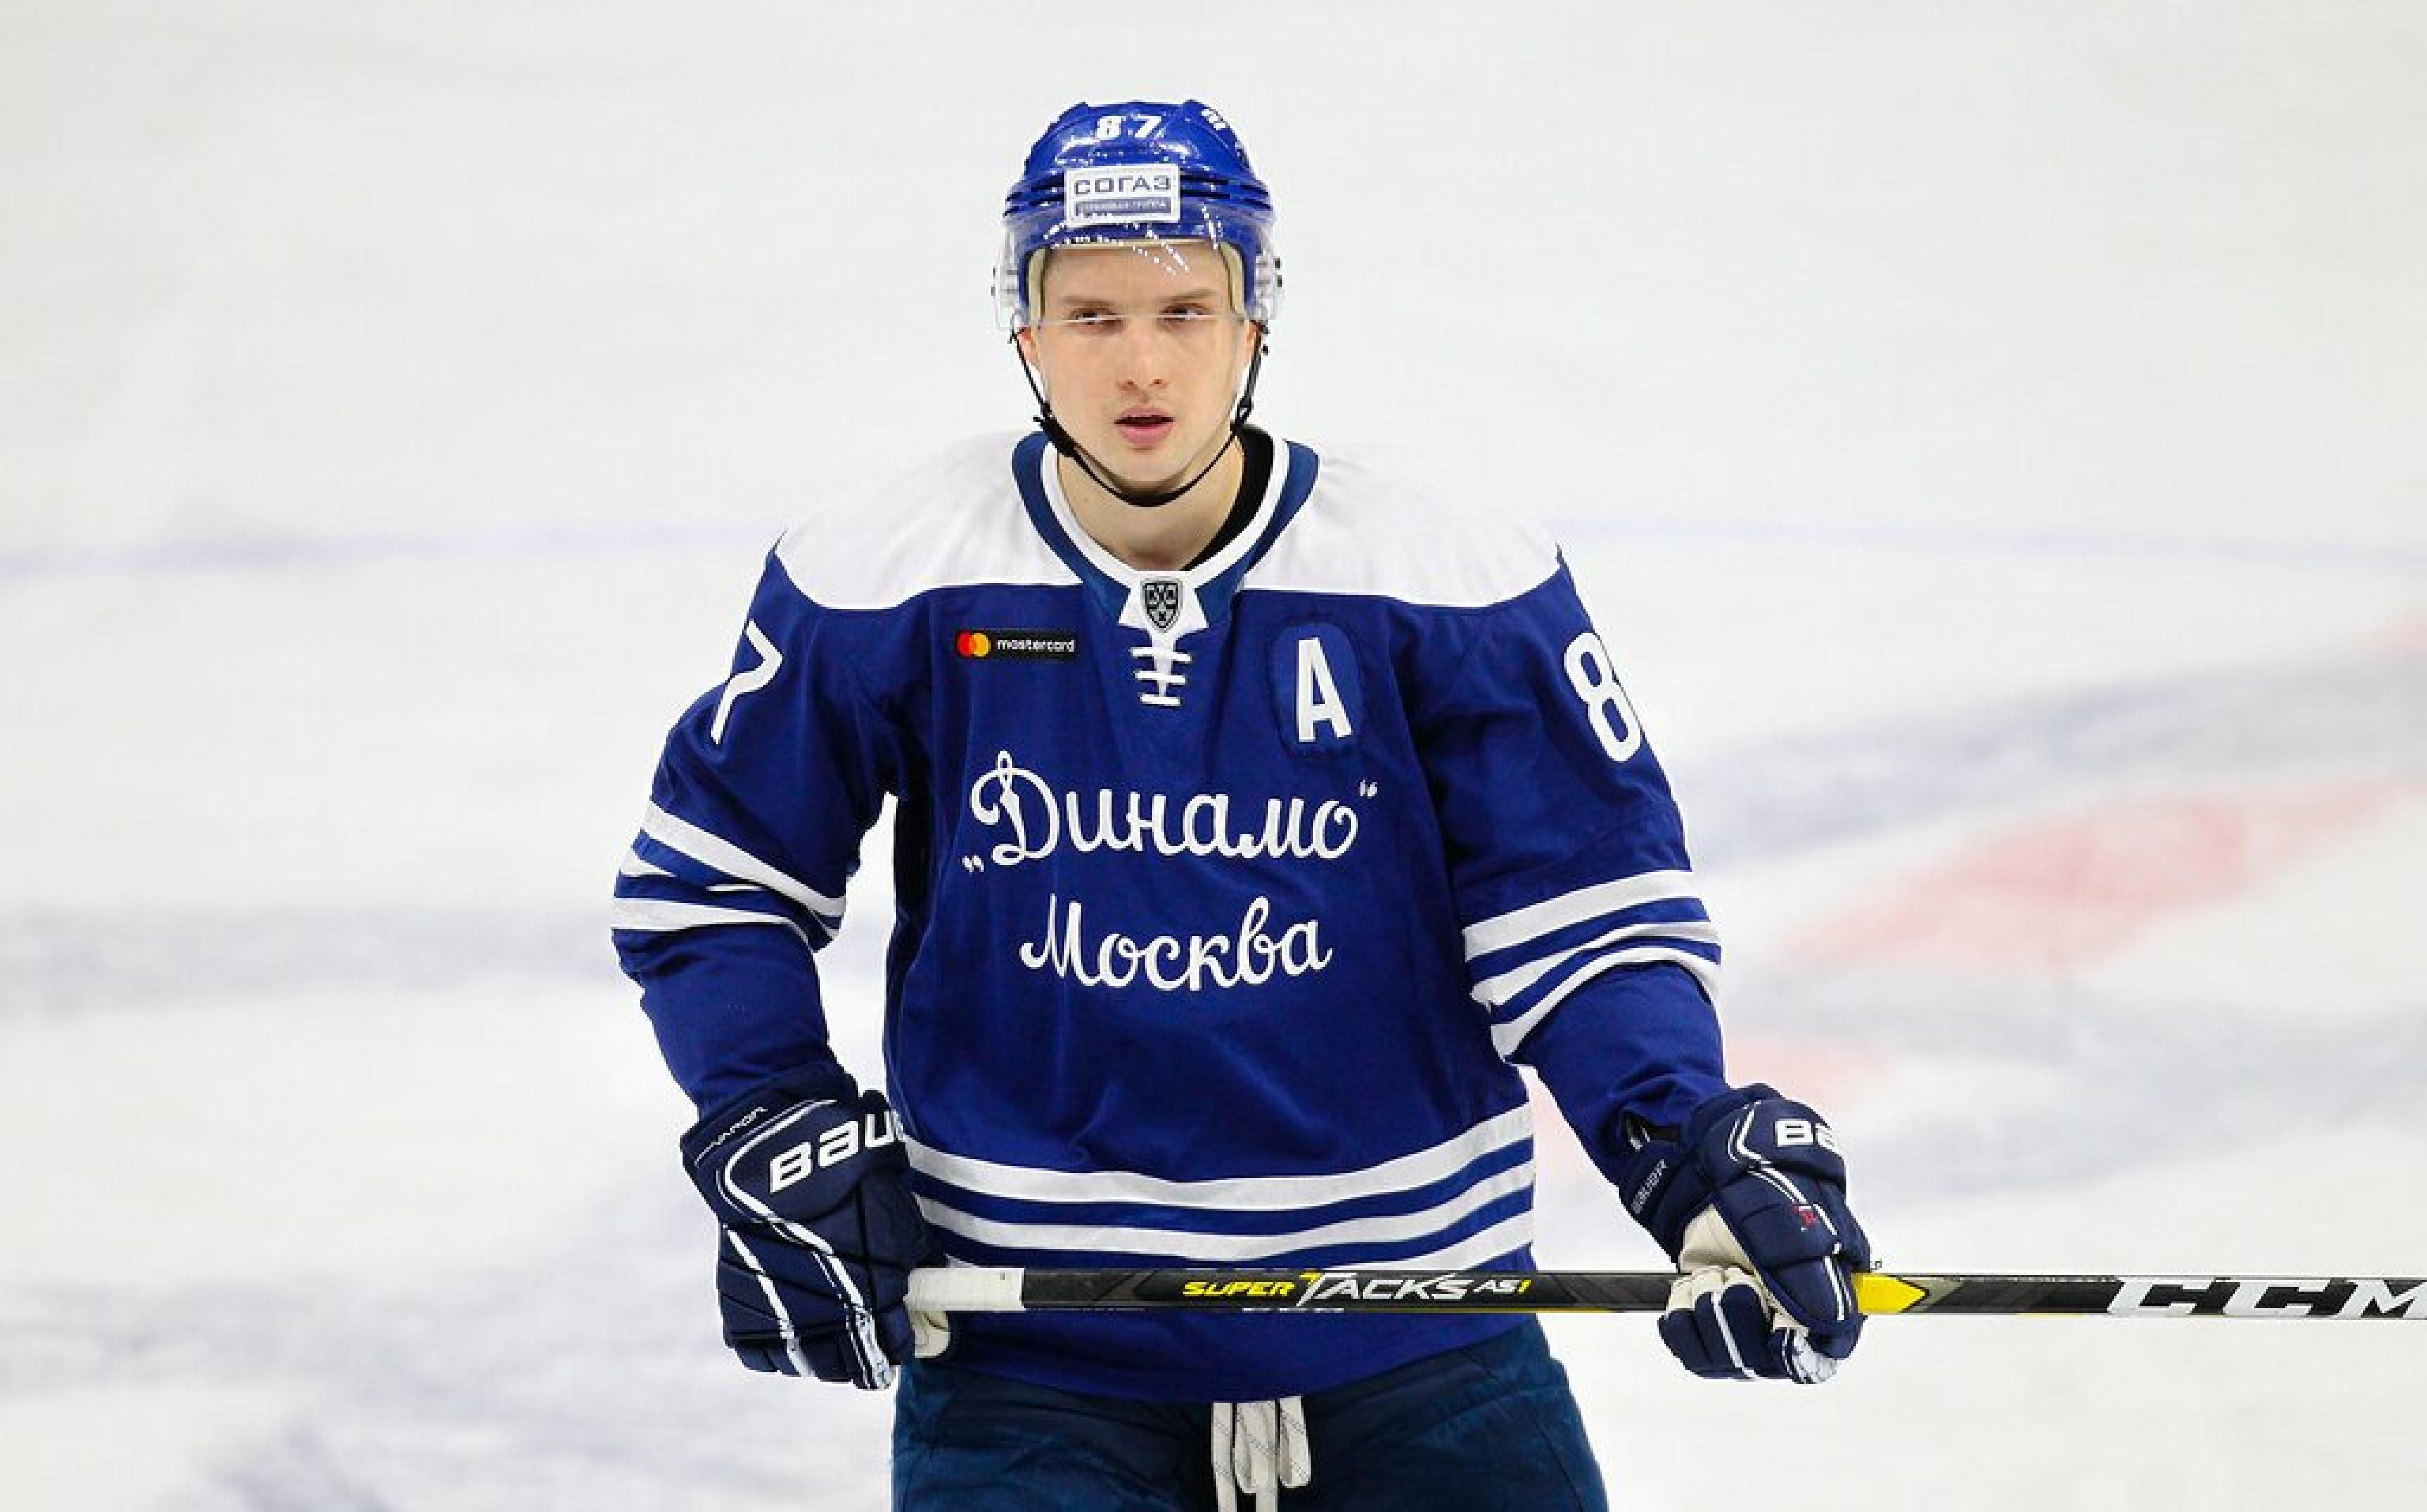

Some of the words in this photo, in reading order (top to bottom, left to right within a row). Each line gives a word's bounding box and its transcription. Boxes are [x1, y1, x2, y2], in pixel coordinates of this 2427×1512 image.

[1097, 115, 1164, 138] 87
[1074, 175, 1171, 195] СОГАЗ
[996, 636, 1075, 653] mastercard
[1296, 636, 1353, 742] A
[1564, 632, 1641, 761] 8
[1020, 893, 1333, 991] Москва
[1182, 1279, 1295, 1297] SUPER
[1296, 1271, 1474, 1307] TACKS
[2106, 1277, 2427, 1319] CCM
